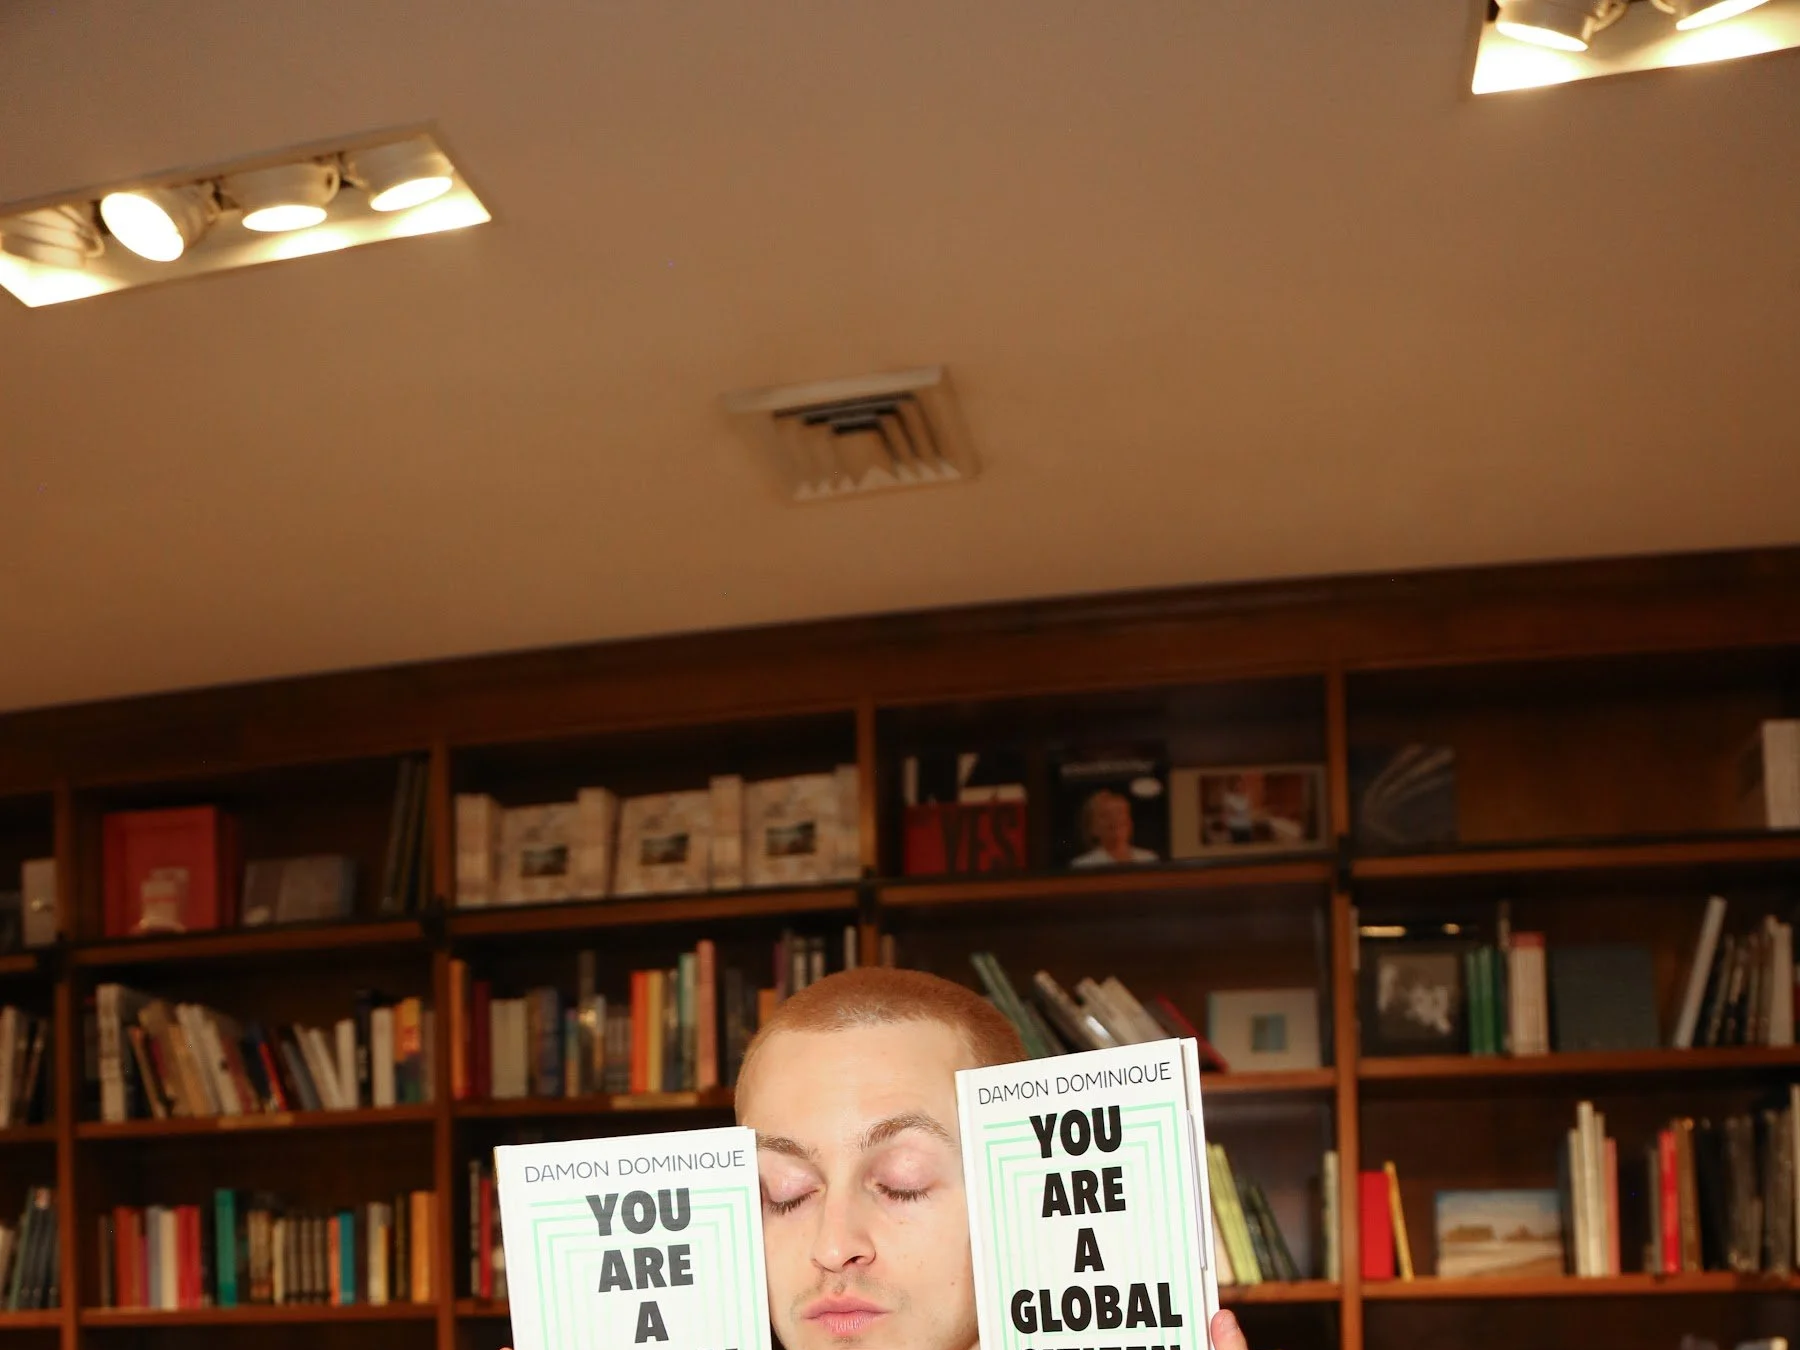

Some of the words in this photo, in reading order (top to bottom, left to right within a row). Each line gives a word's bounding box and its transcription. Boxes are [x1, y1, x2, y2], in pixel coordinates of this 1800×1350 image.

[978, 1079, 1049, 1105] DAMON
[1056, 1062, 1172, 1095] DOMINIQUE
[1029, 1105, 1122, 1158] YOU
[524, 1160, 609, 1183] DAMON
[618, 1150, 746, 1176] DOMINIQUE
[585, 1188, 691, 1236] YOU
[1042, 1166, 1126, 1218] ARE
[598, 1244, 694, 1293] ARE
[1074, 1227, 1105, 1273] A
[634, 1301, 669, 1343] A
[1011, 1282, 1183, 1334] GLOBAL
